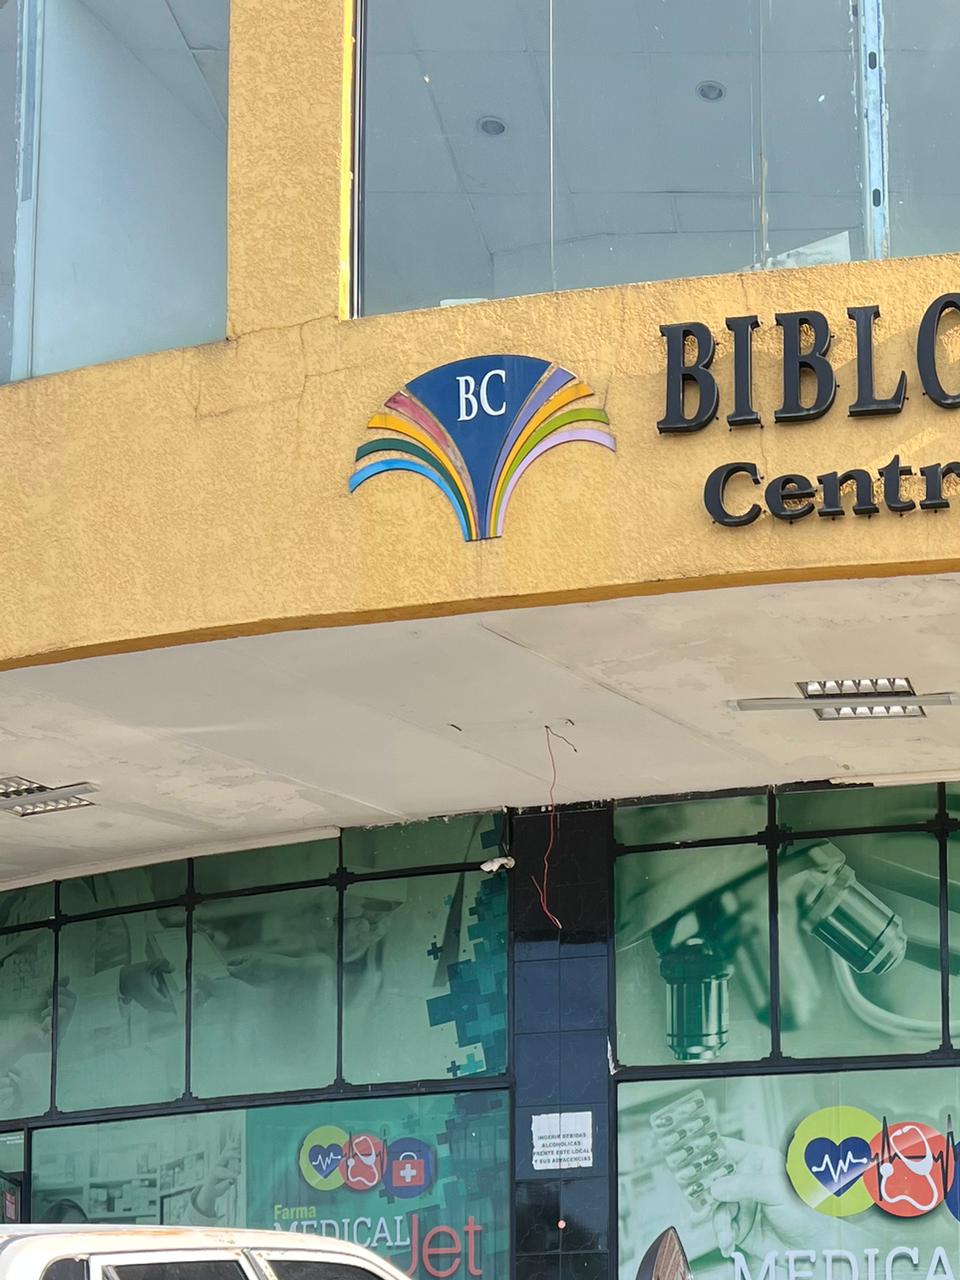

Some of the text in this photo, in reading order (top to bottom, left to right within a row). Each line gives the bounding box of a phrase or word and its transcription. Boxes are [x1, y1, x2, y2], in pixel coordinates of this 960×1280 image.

[456, 370, 506, 424] BC
[273, 1204, 317, 1220] Farma
[386, 1213, 483, 1278] Jet
